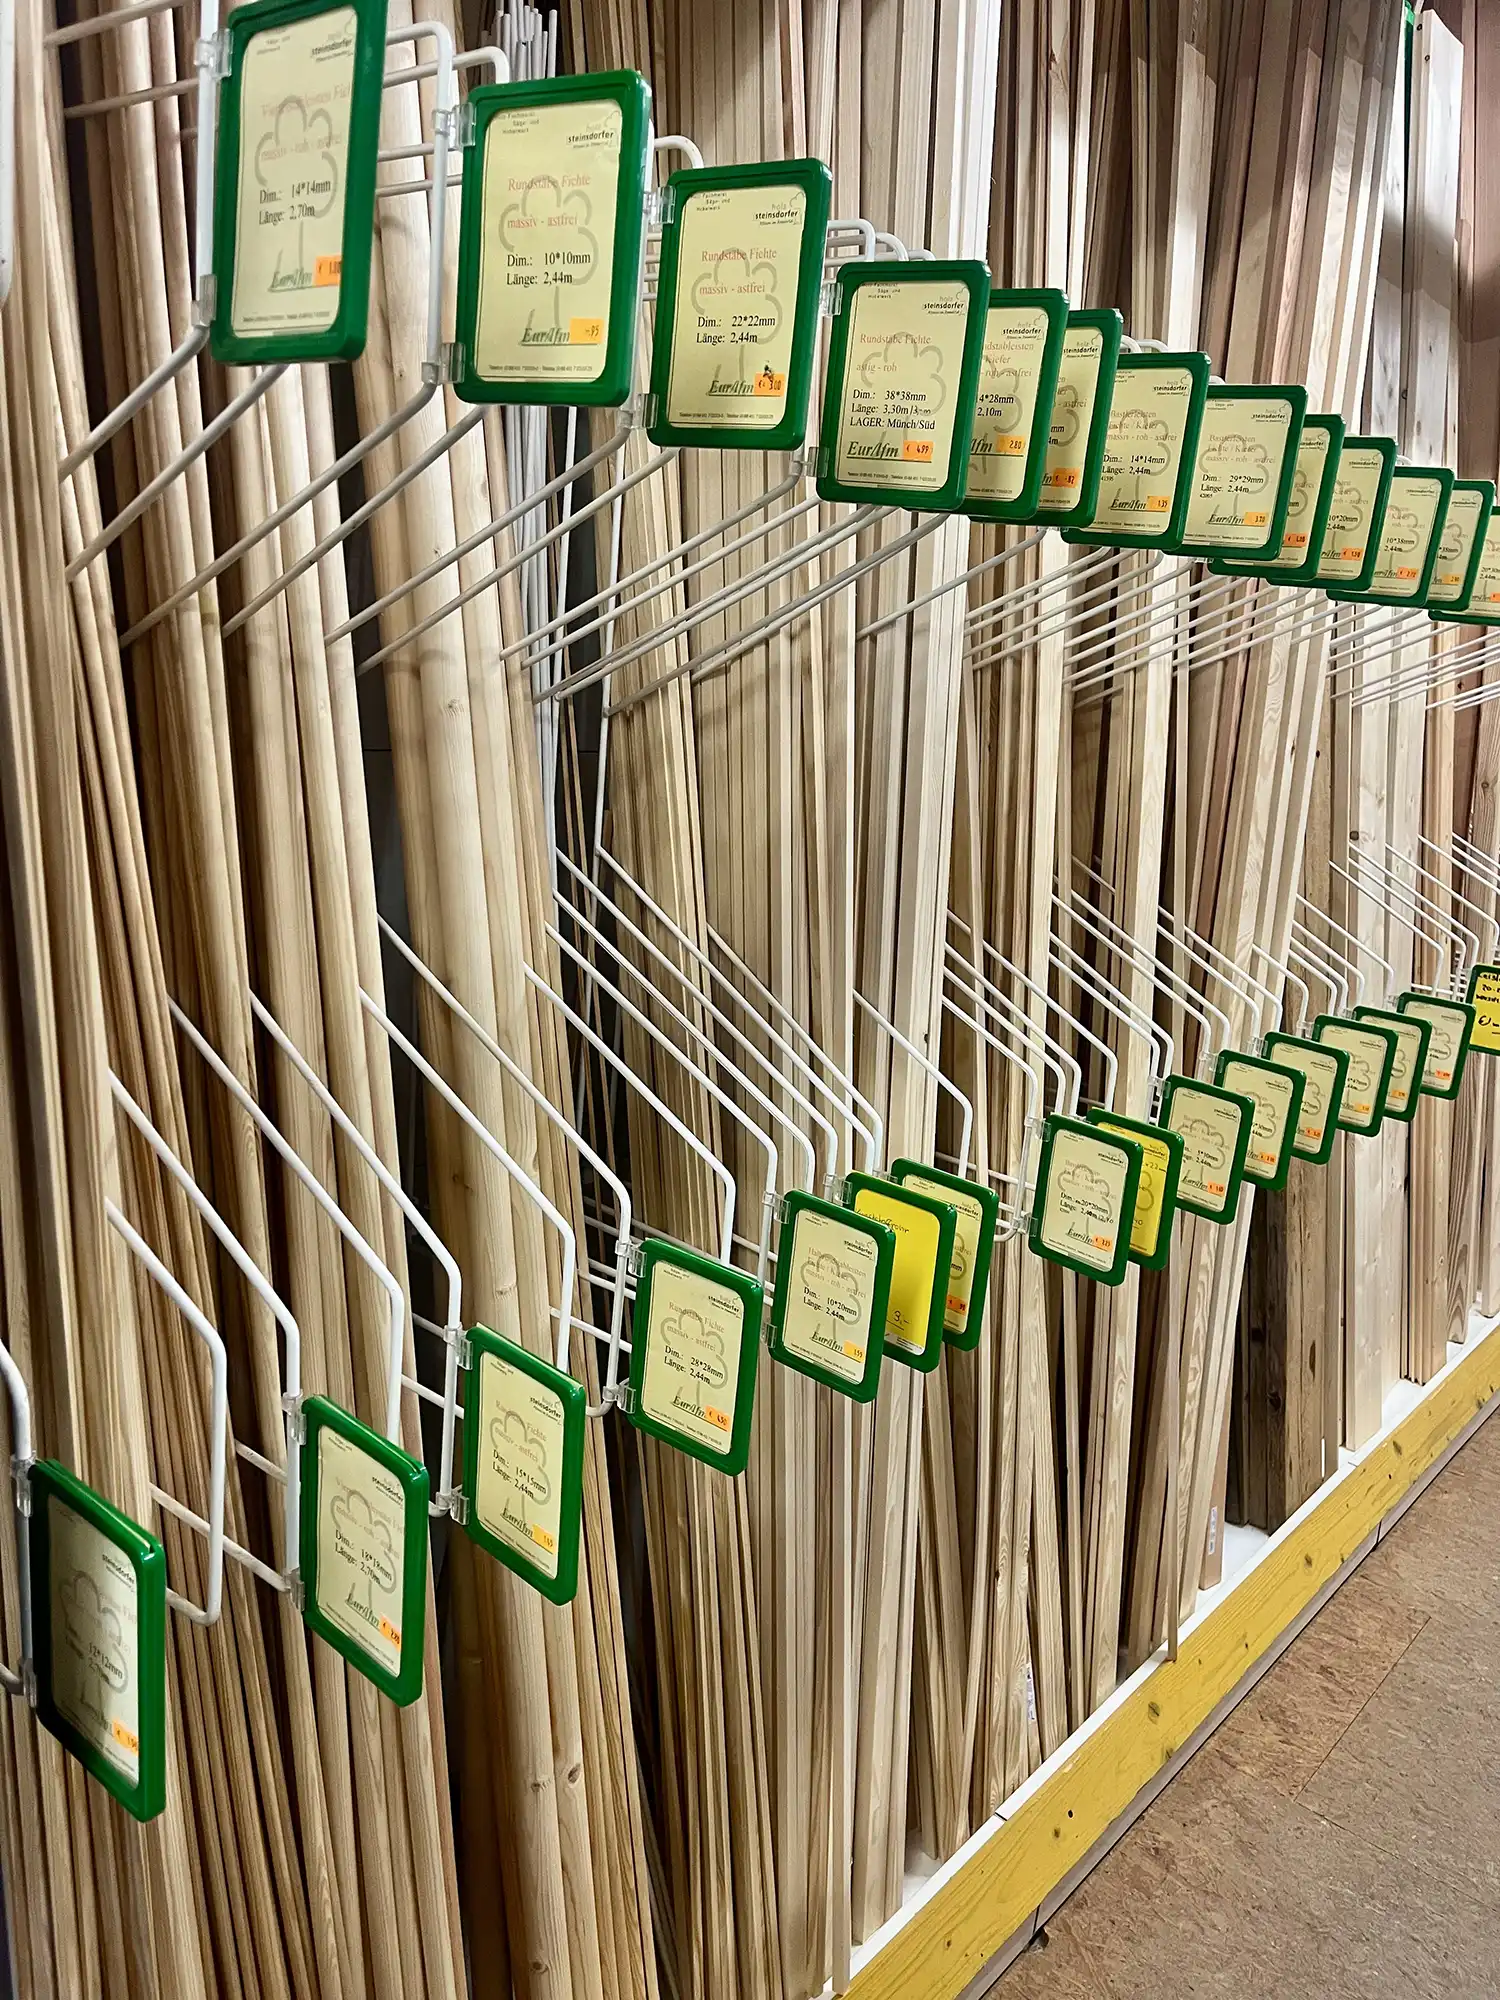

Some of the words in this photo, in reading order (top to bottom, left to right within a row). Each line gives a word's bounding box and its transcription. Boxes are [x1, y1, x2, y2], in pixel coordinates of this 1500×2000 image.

[568, 131, 614, 143] steinsdorfer
[562, 173, 591, 188] Fichte
[507, 213, 537, 229] massiv
[548, 213, 578, 227] astfrei
[755, 210, 798, 220] steinsdorfer
[507, 254, 532, 267] Dim.:
[701, 248, 747, 262] Rundstäbe
[750, 247, 777, 260] Fichte
[506, 273, 538, 288] Länge:
[543, 271, 573, 286] 2,44m
[700, 283, 728, 296] massiv
[737, 281, 765, 293] astfrei
[924, 302, 964, 310] steinsdorfer
[697, 316, 722, 327] Dim.:
[696, 333, 725, 346] Länge:
[730, 332, 758, 344] 2,44m
[860, 334, 902, 344] Rundstäbe
[905, 335, 931, 344] Fichte
[1063, 346, 1098, 354] steinsdorfer
[883, 362, 897, 372] roh
[1006, 367, 1032, 377] astfrei
[853, 389, 876, 399] Dim.:
[851, 403, 879, 415] Länge:
[850, 417, 884, 428] LAGER:
[887, 419, 935, 430] Münch/Süd
[1136, 432, 1149, 441] roh
[1103, 454, 1123, 463] Dim.:
[1102, 466, 1125, 475] Länge:
[1129, 466, 1151, 475] 2,44m
[1201, 484, 1224, 493] Länge:
[804, 1287, 820, 1300] Dim.:
[708, 1296, 739, 1313] steinsdorfer
[803, 1297, 823, 1311] Länge:
[705, 1316, 725, 1333] Fichte
[664, 1345, 684, 1360] Dim.:
[663, 1356, 686, 1373] Länge:
[690, 1368, 711, 1385] 2,44m
[530, 1397, 562, 1419] steinsdorfer
[493, 1449, 510, 1468] Dim.:
[492, 1461, 512, 1483] Länge:
[514, 1478, 534, 1499] 2,44m
